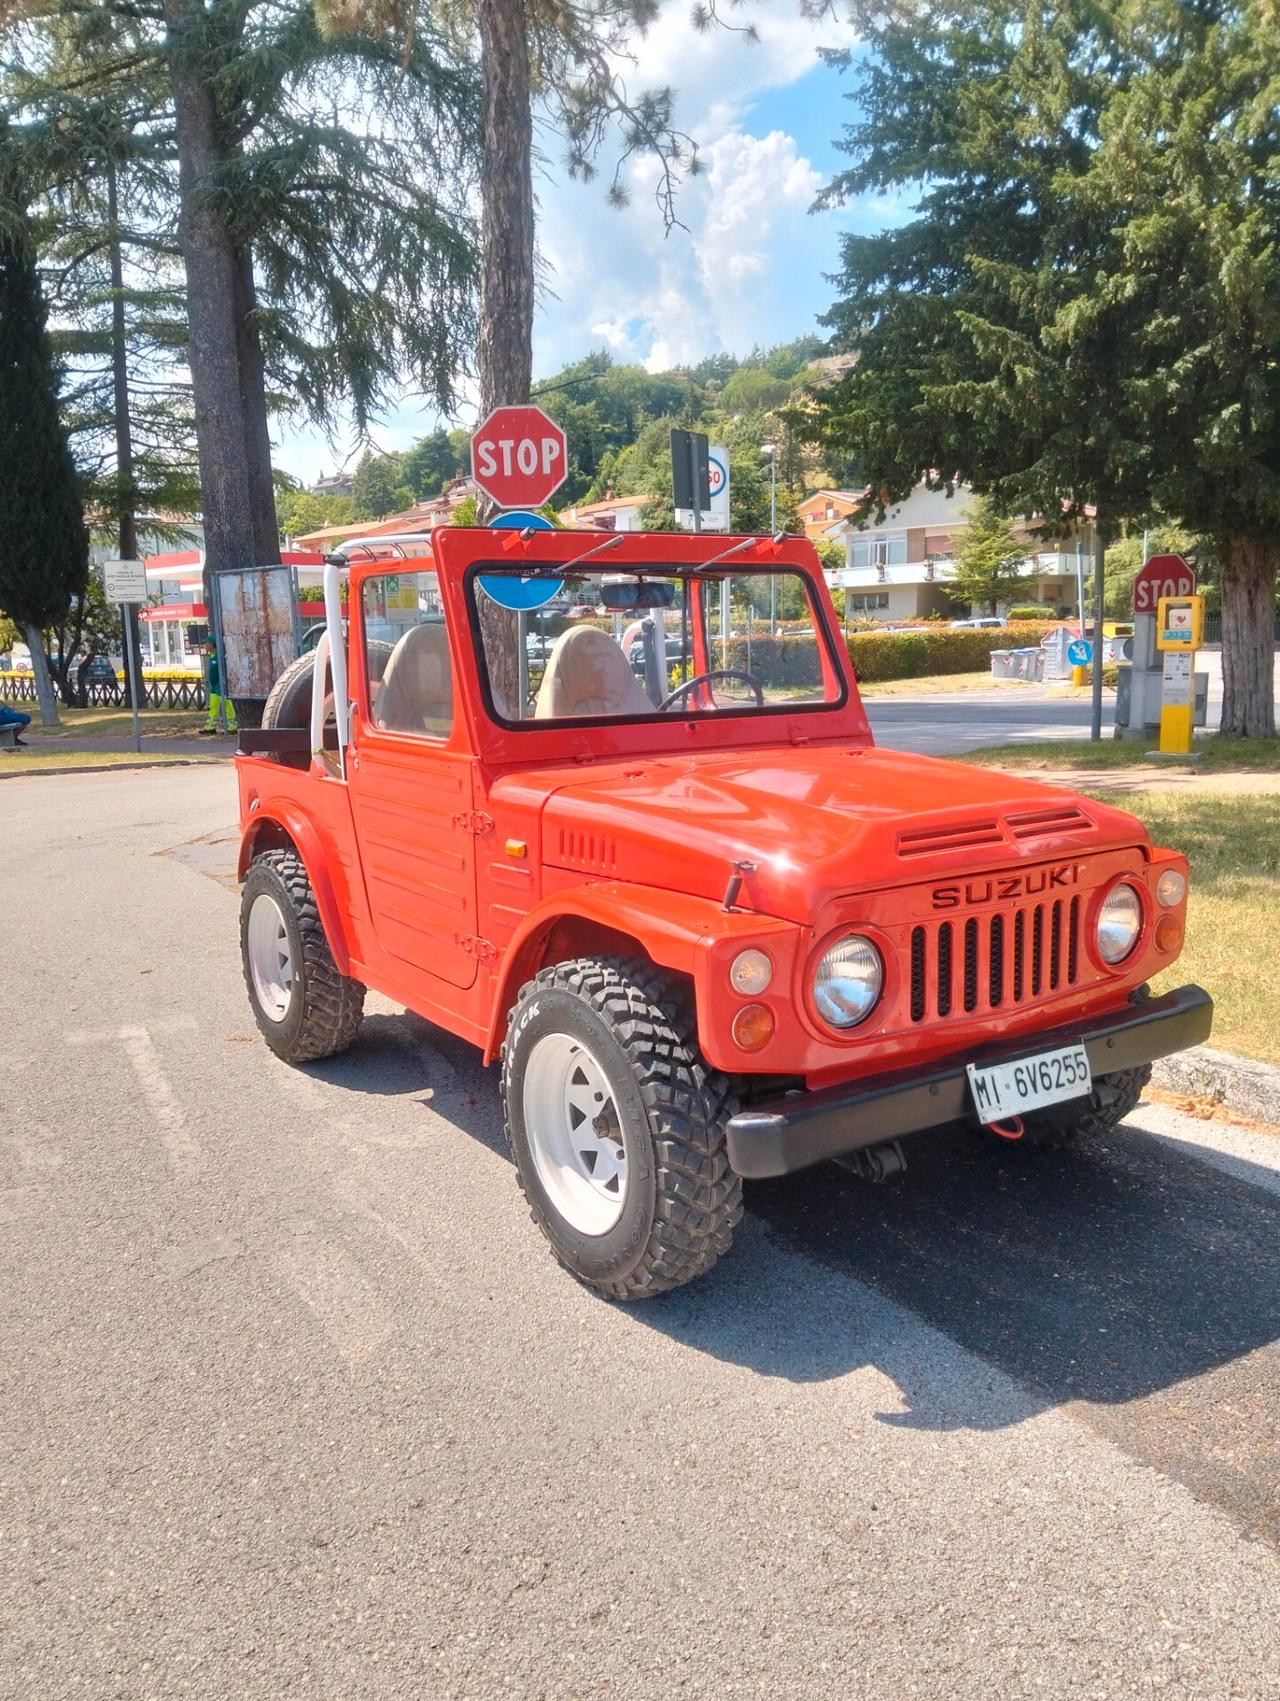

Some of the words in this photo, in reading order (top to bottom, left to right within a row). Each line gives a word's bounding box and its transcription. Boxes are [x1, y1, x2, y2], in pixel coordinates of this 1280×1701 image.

[478, 438, 560, 477] STOP
[1137, 577, 1191, 608] STOP
[932, 863, 1079, 909] SUZUKI
[974, 1075, 1001, 1109] MI
[1014, 1052, 1088, 1098] 6V6255
